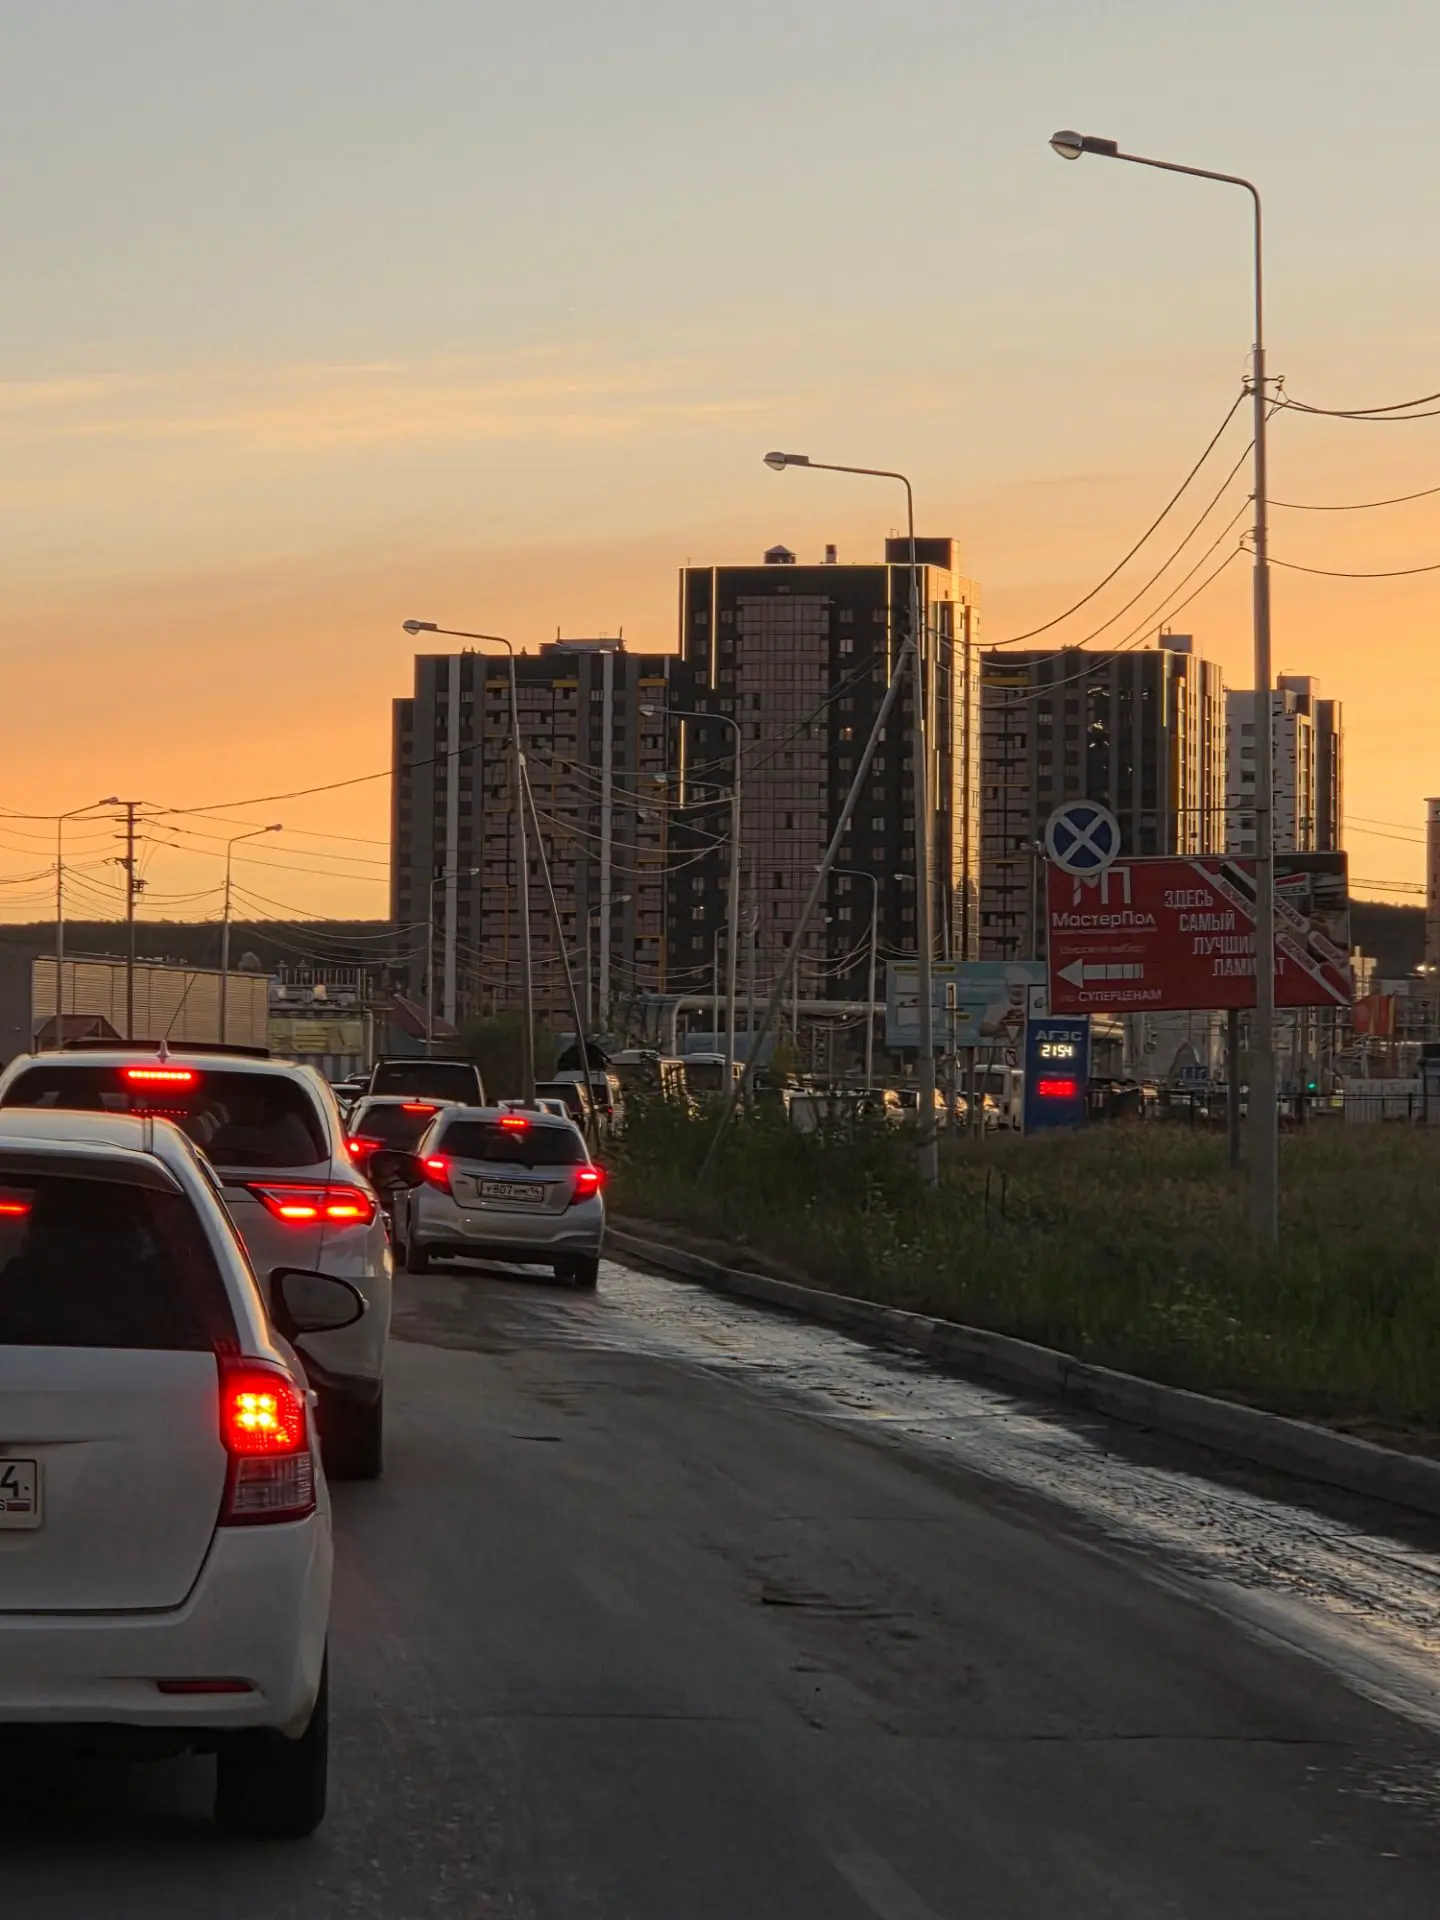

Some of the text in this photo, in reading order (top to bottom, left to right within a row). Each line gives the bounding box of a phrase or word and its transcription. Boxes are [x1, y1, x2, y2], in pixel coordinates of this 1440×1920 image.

[1164, 889, 1213, 908] ЗДЕСЬ
[1052, 911, 1156, 927] МастерПол
[1179, 910, 1235, 932] САМЫЙ
